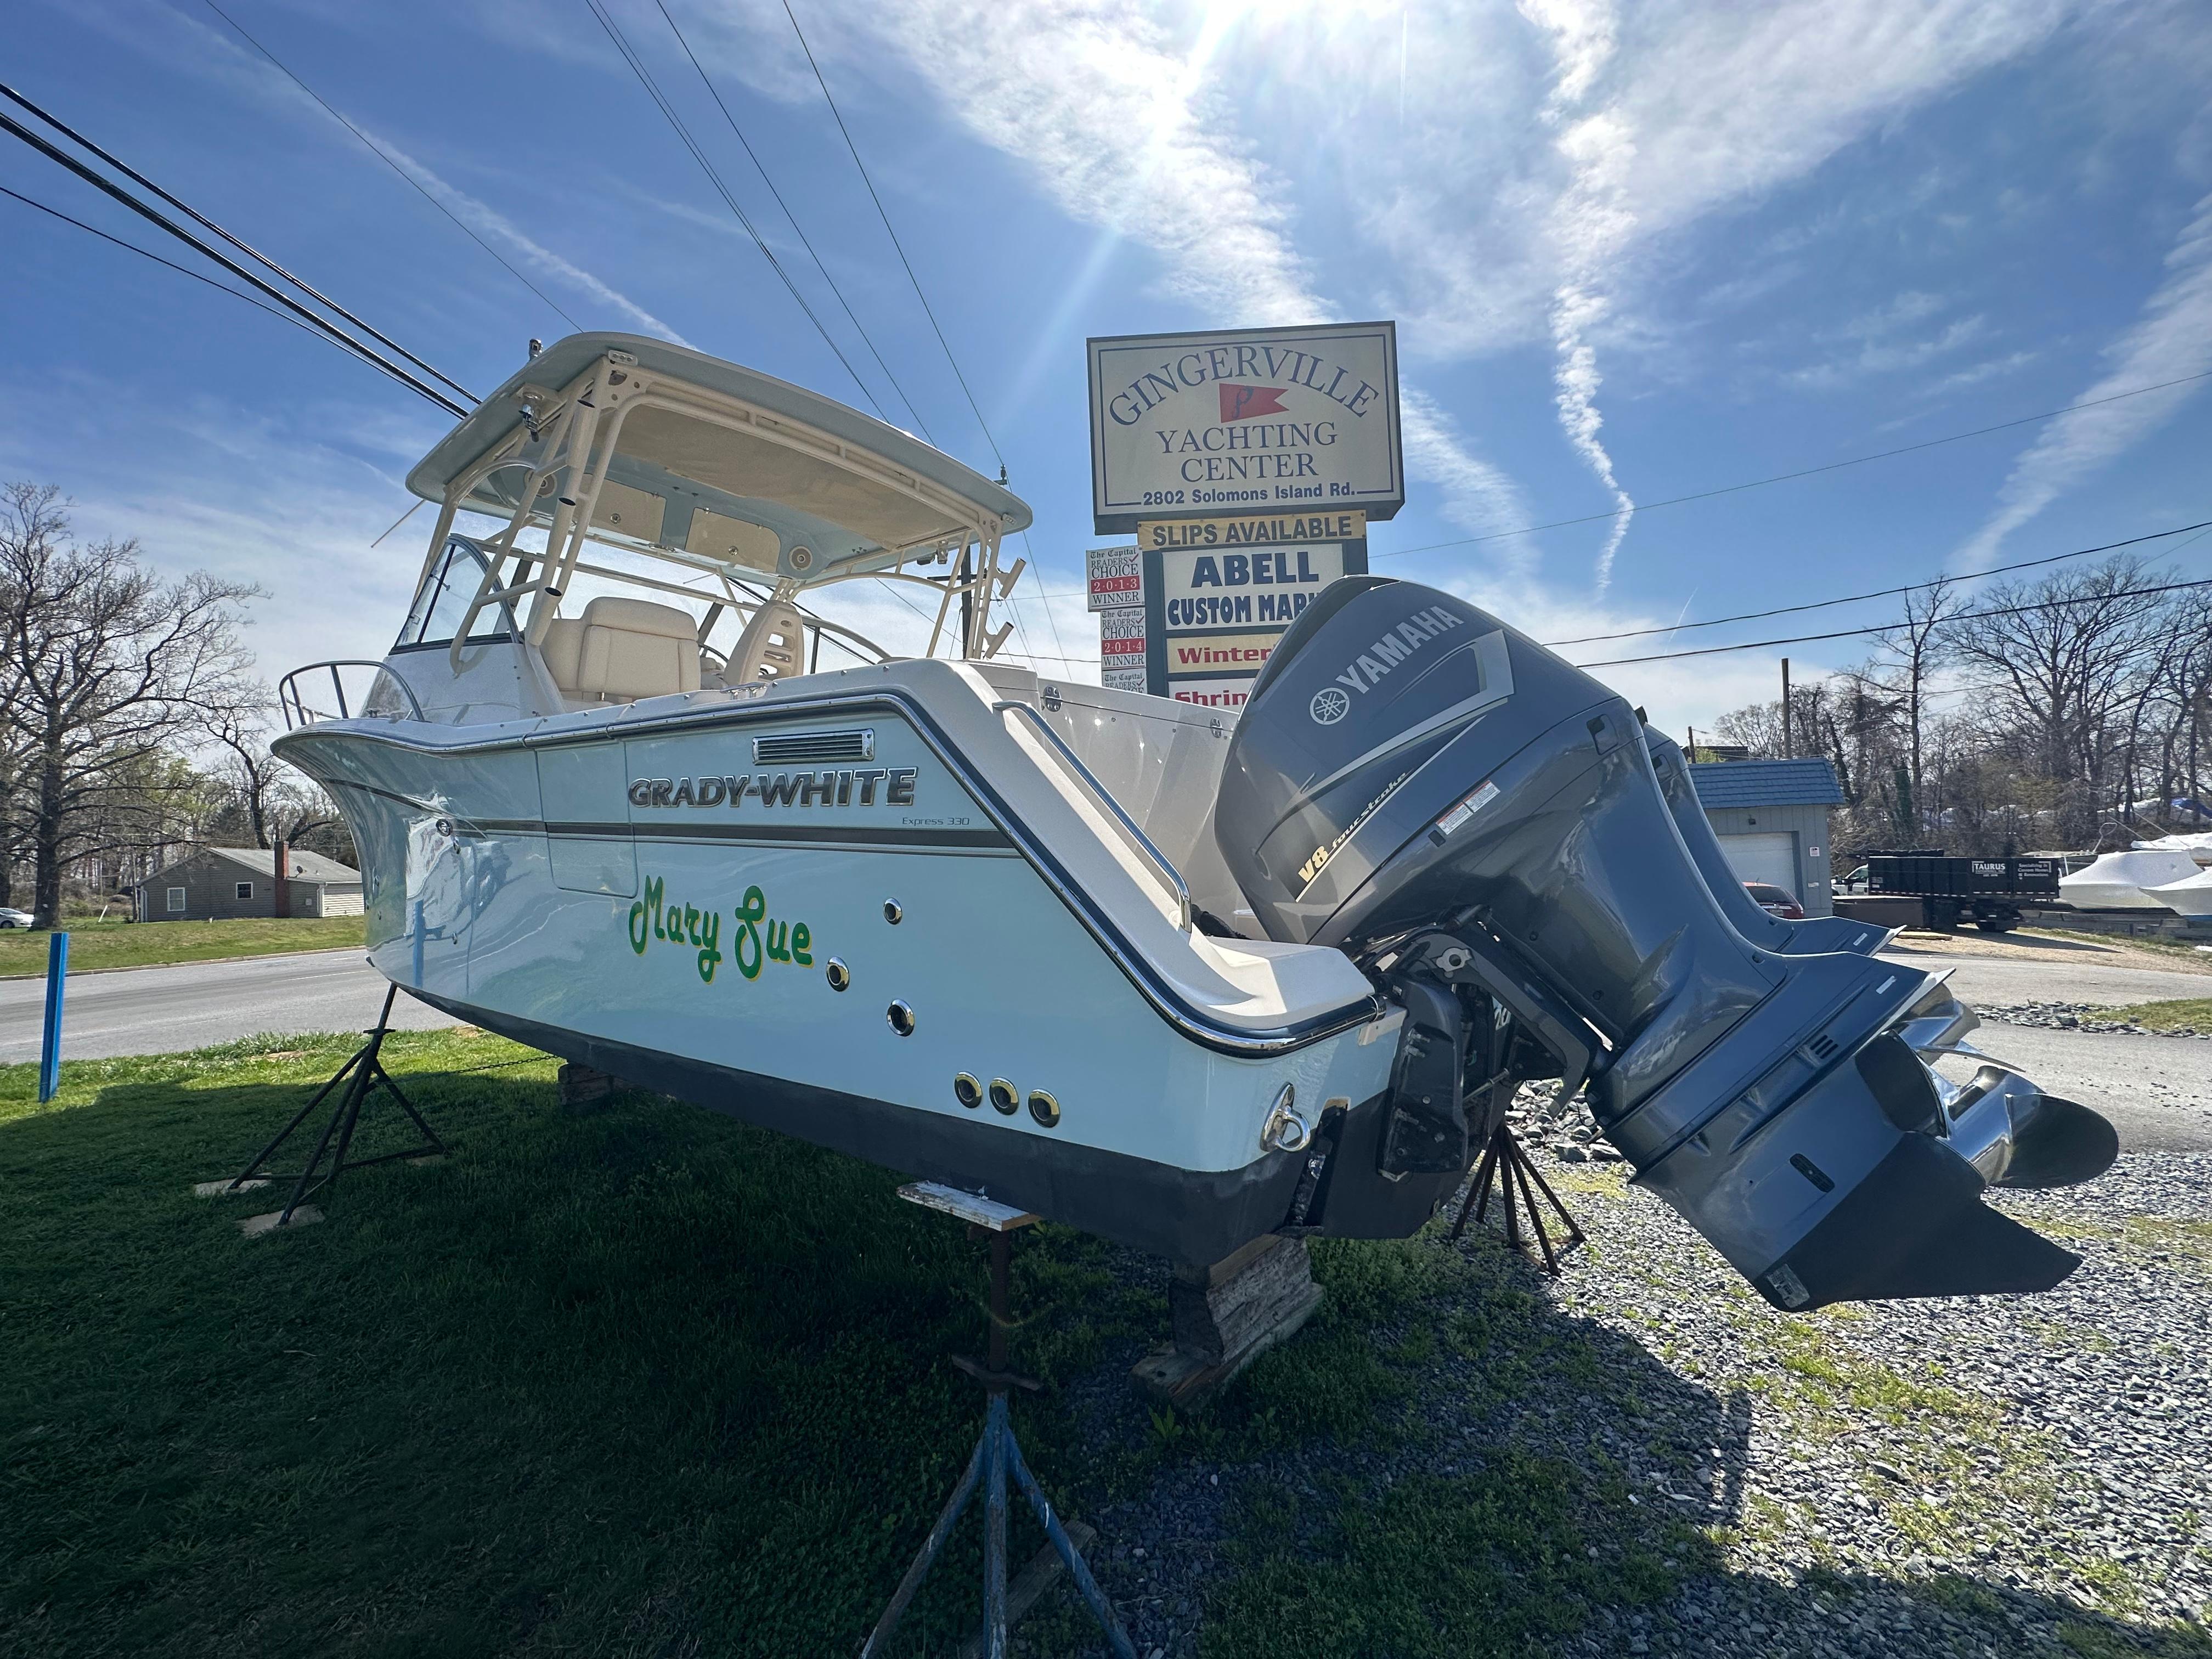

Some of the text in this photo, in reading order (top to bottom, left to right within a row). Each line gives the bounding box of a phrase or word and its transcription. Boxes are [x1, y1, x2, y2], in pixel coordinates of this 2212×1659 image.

[1109, 346, 1379, 426] GINGERVILLE
[1155, 421, 1338, 454] YACHTING
[1181, 453, 1319, 483] CENTER
[1143, 482, 1355, 505] 2802 Solomons Island Rd.
[1153, 516, 1352, 546] SLIPS AVAILABLE
[1090, 547, 1136, 559] The Capital
[1091, 557, 1128, 568] READERS
[1092, 563, 1138, 579] CHOICE
[1191, 551, 1319, 588] ABELL
[1092, 591, 1139, 605] WINNER
[1167, 595, 1251, 626] CUSTOM
[1102, 618, 1135, 628] READERS
[1117, 608, 1142, 618] Capital
[1103, 625, 1144, 640] CHOICE
[1103, 654, 1144, 666] WINNER
[1335, 606, 1464, 694] YAMAHA
[628, 766, 919, 809] GRADY-WHITE
[902, 817, 970, 826] Express 330
[1298, 845, 1329, 883] V8
[629, 874, 815, 984] Mary Sue
